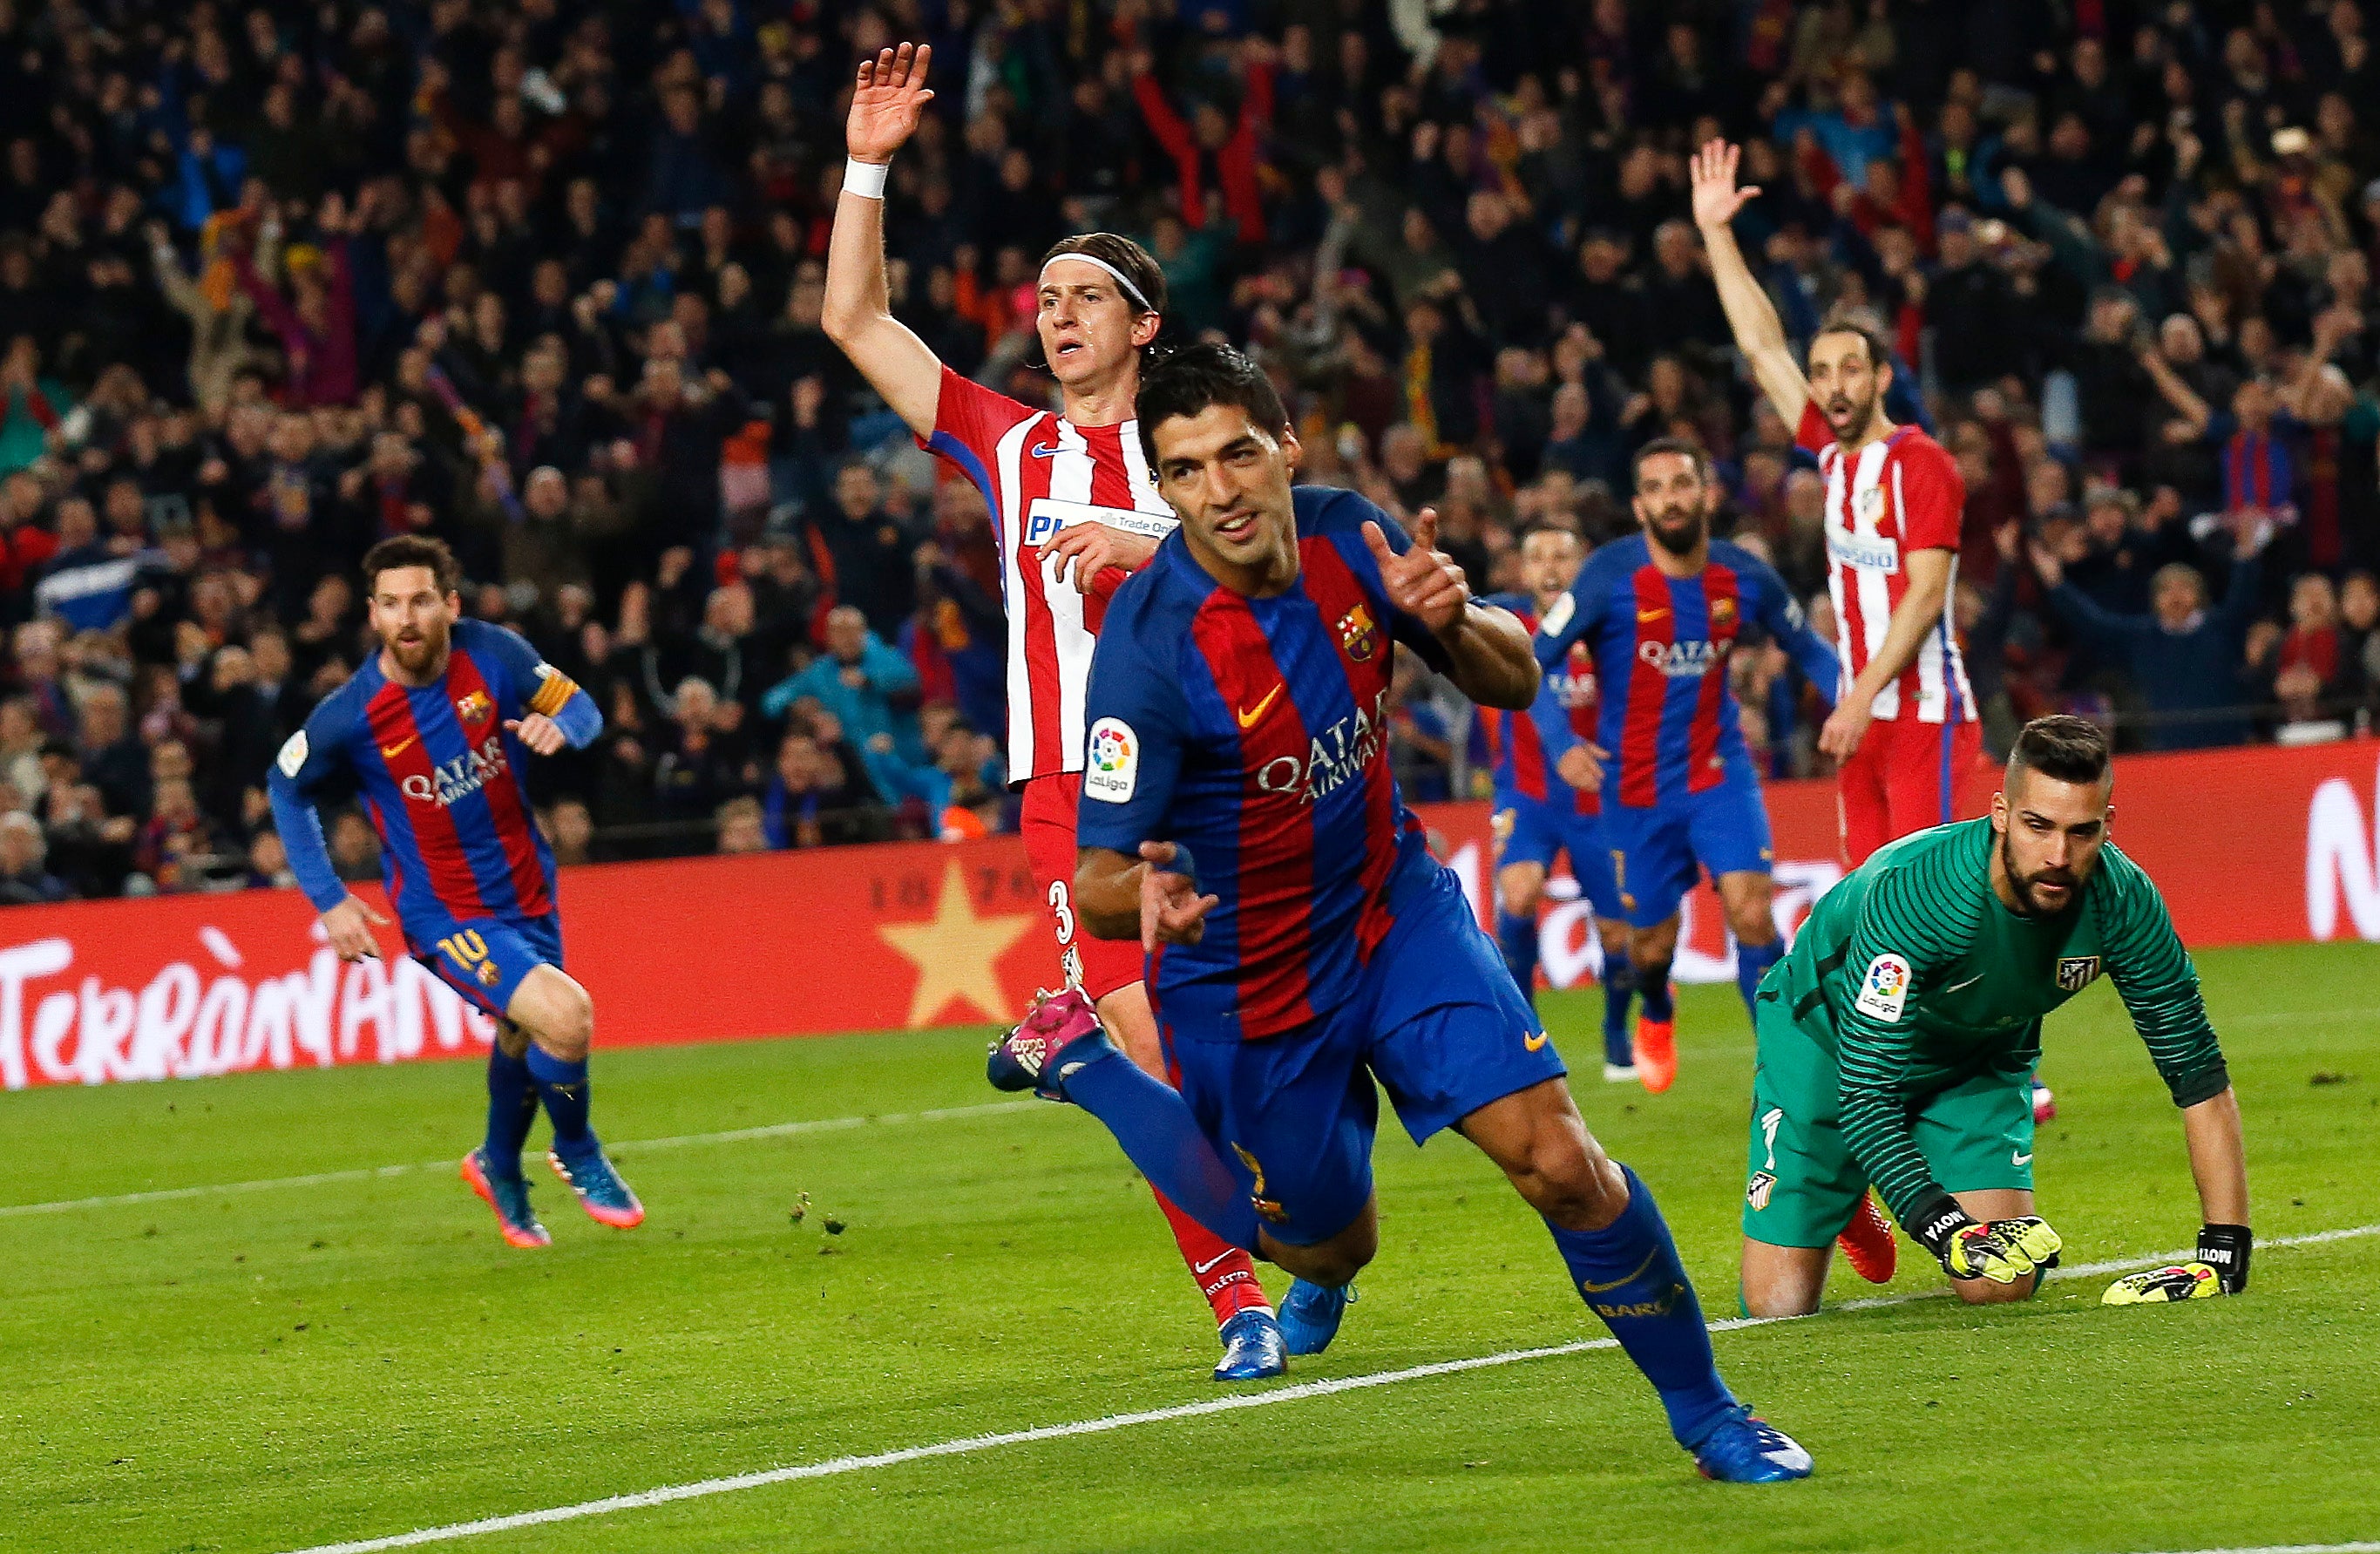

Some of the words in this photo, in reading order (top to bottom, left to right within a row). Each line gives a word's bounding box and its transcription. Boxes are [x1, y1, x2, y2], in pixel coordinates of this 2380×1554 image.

[1119, 516, 1150, 531] Trade
[401, 736, 505, 802] QATAR
[1048, 879, 1075, 945] 3
[437, 928, 489, 972] 10
[1924, 1210, 1966, 1242] MOYA
